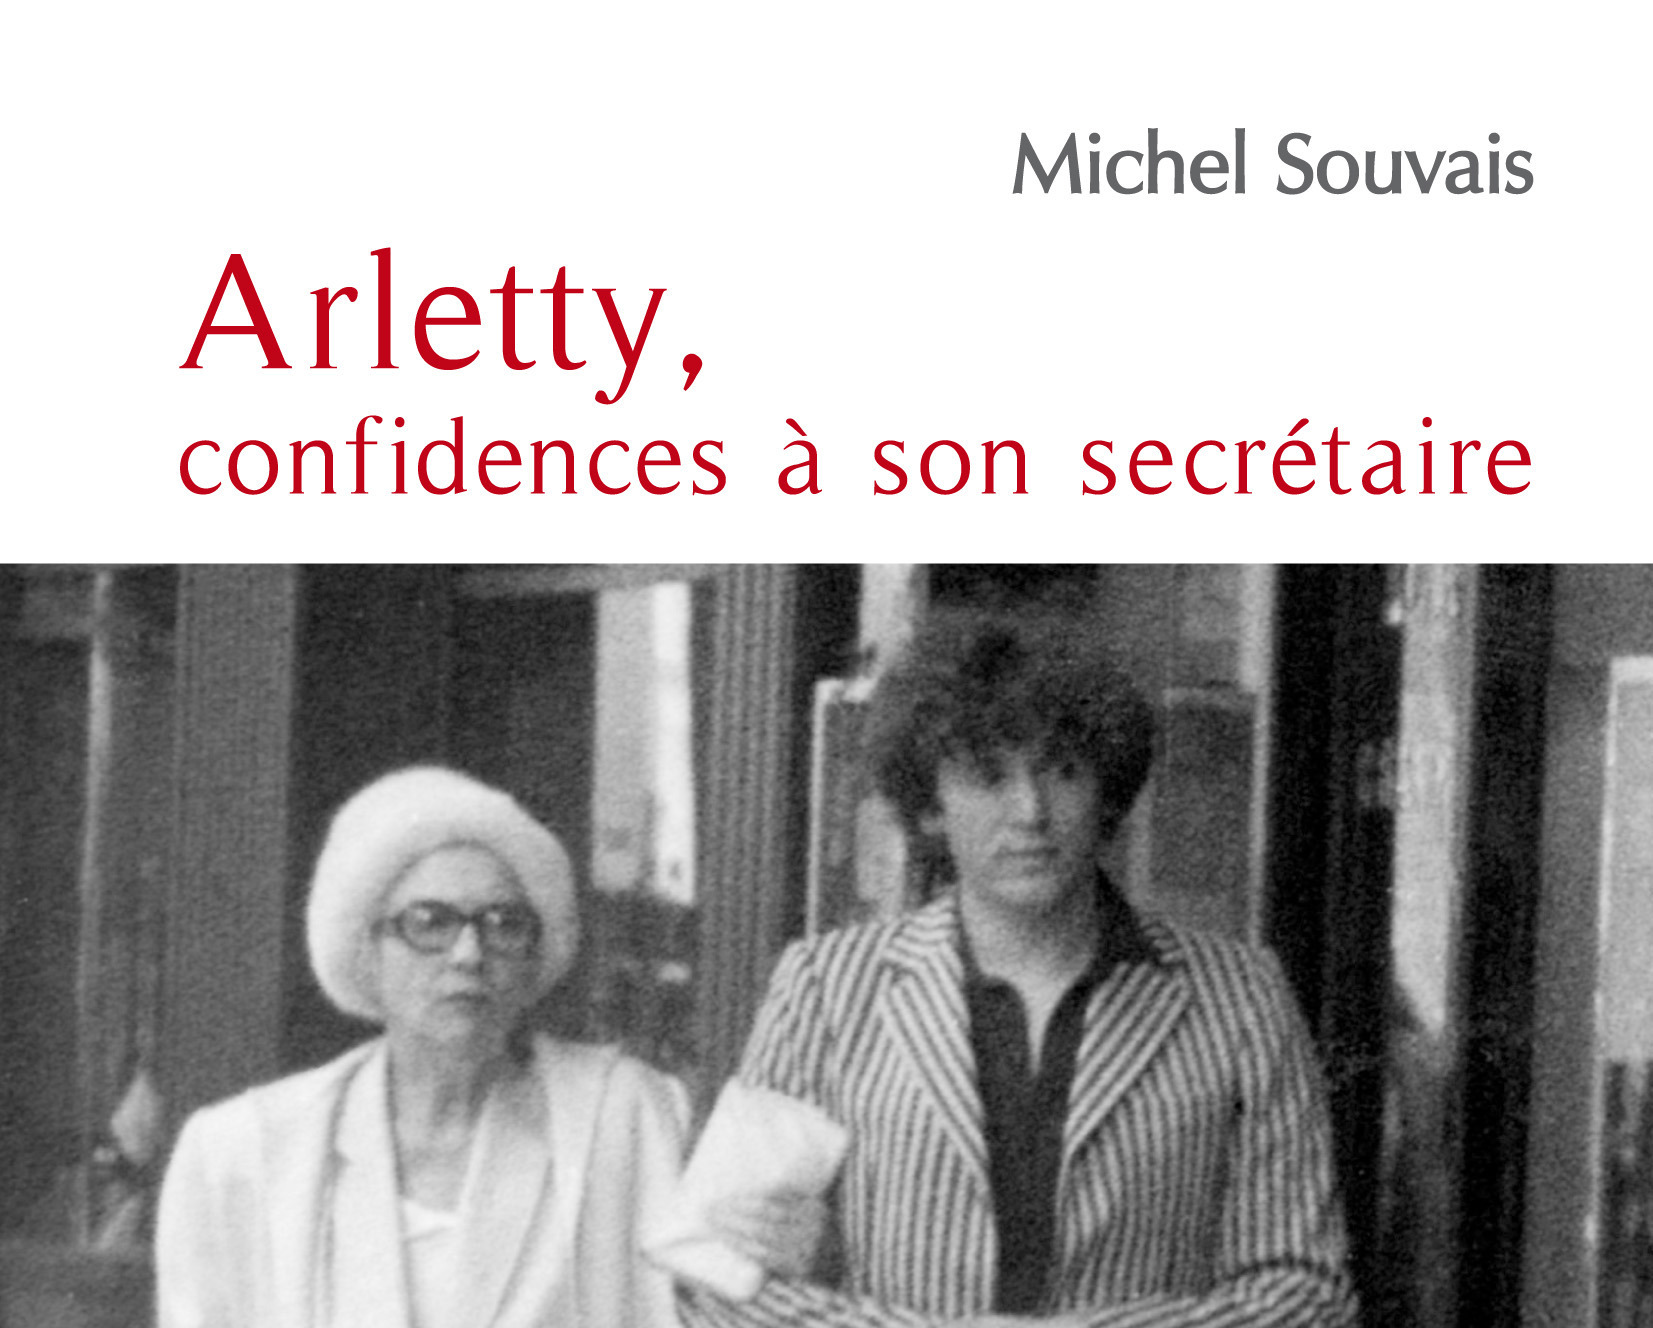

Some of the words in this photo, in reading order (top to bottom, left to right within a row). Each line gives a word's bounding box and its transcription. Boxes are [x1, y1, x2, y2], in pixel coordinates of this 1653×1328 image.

[1012, 127, 1246, 195] Michel
[1276, 132, 1534, 195] Souvais
[178, 246, 703, 406] Arletty,
[179, 414, 727, 496] confidences
[777, 417, 823, 496] à
[873, 439, 1029, 496] son
[1082, 416, 1532, 496] secrétaire
